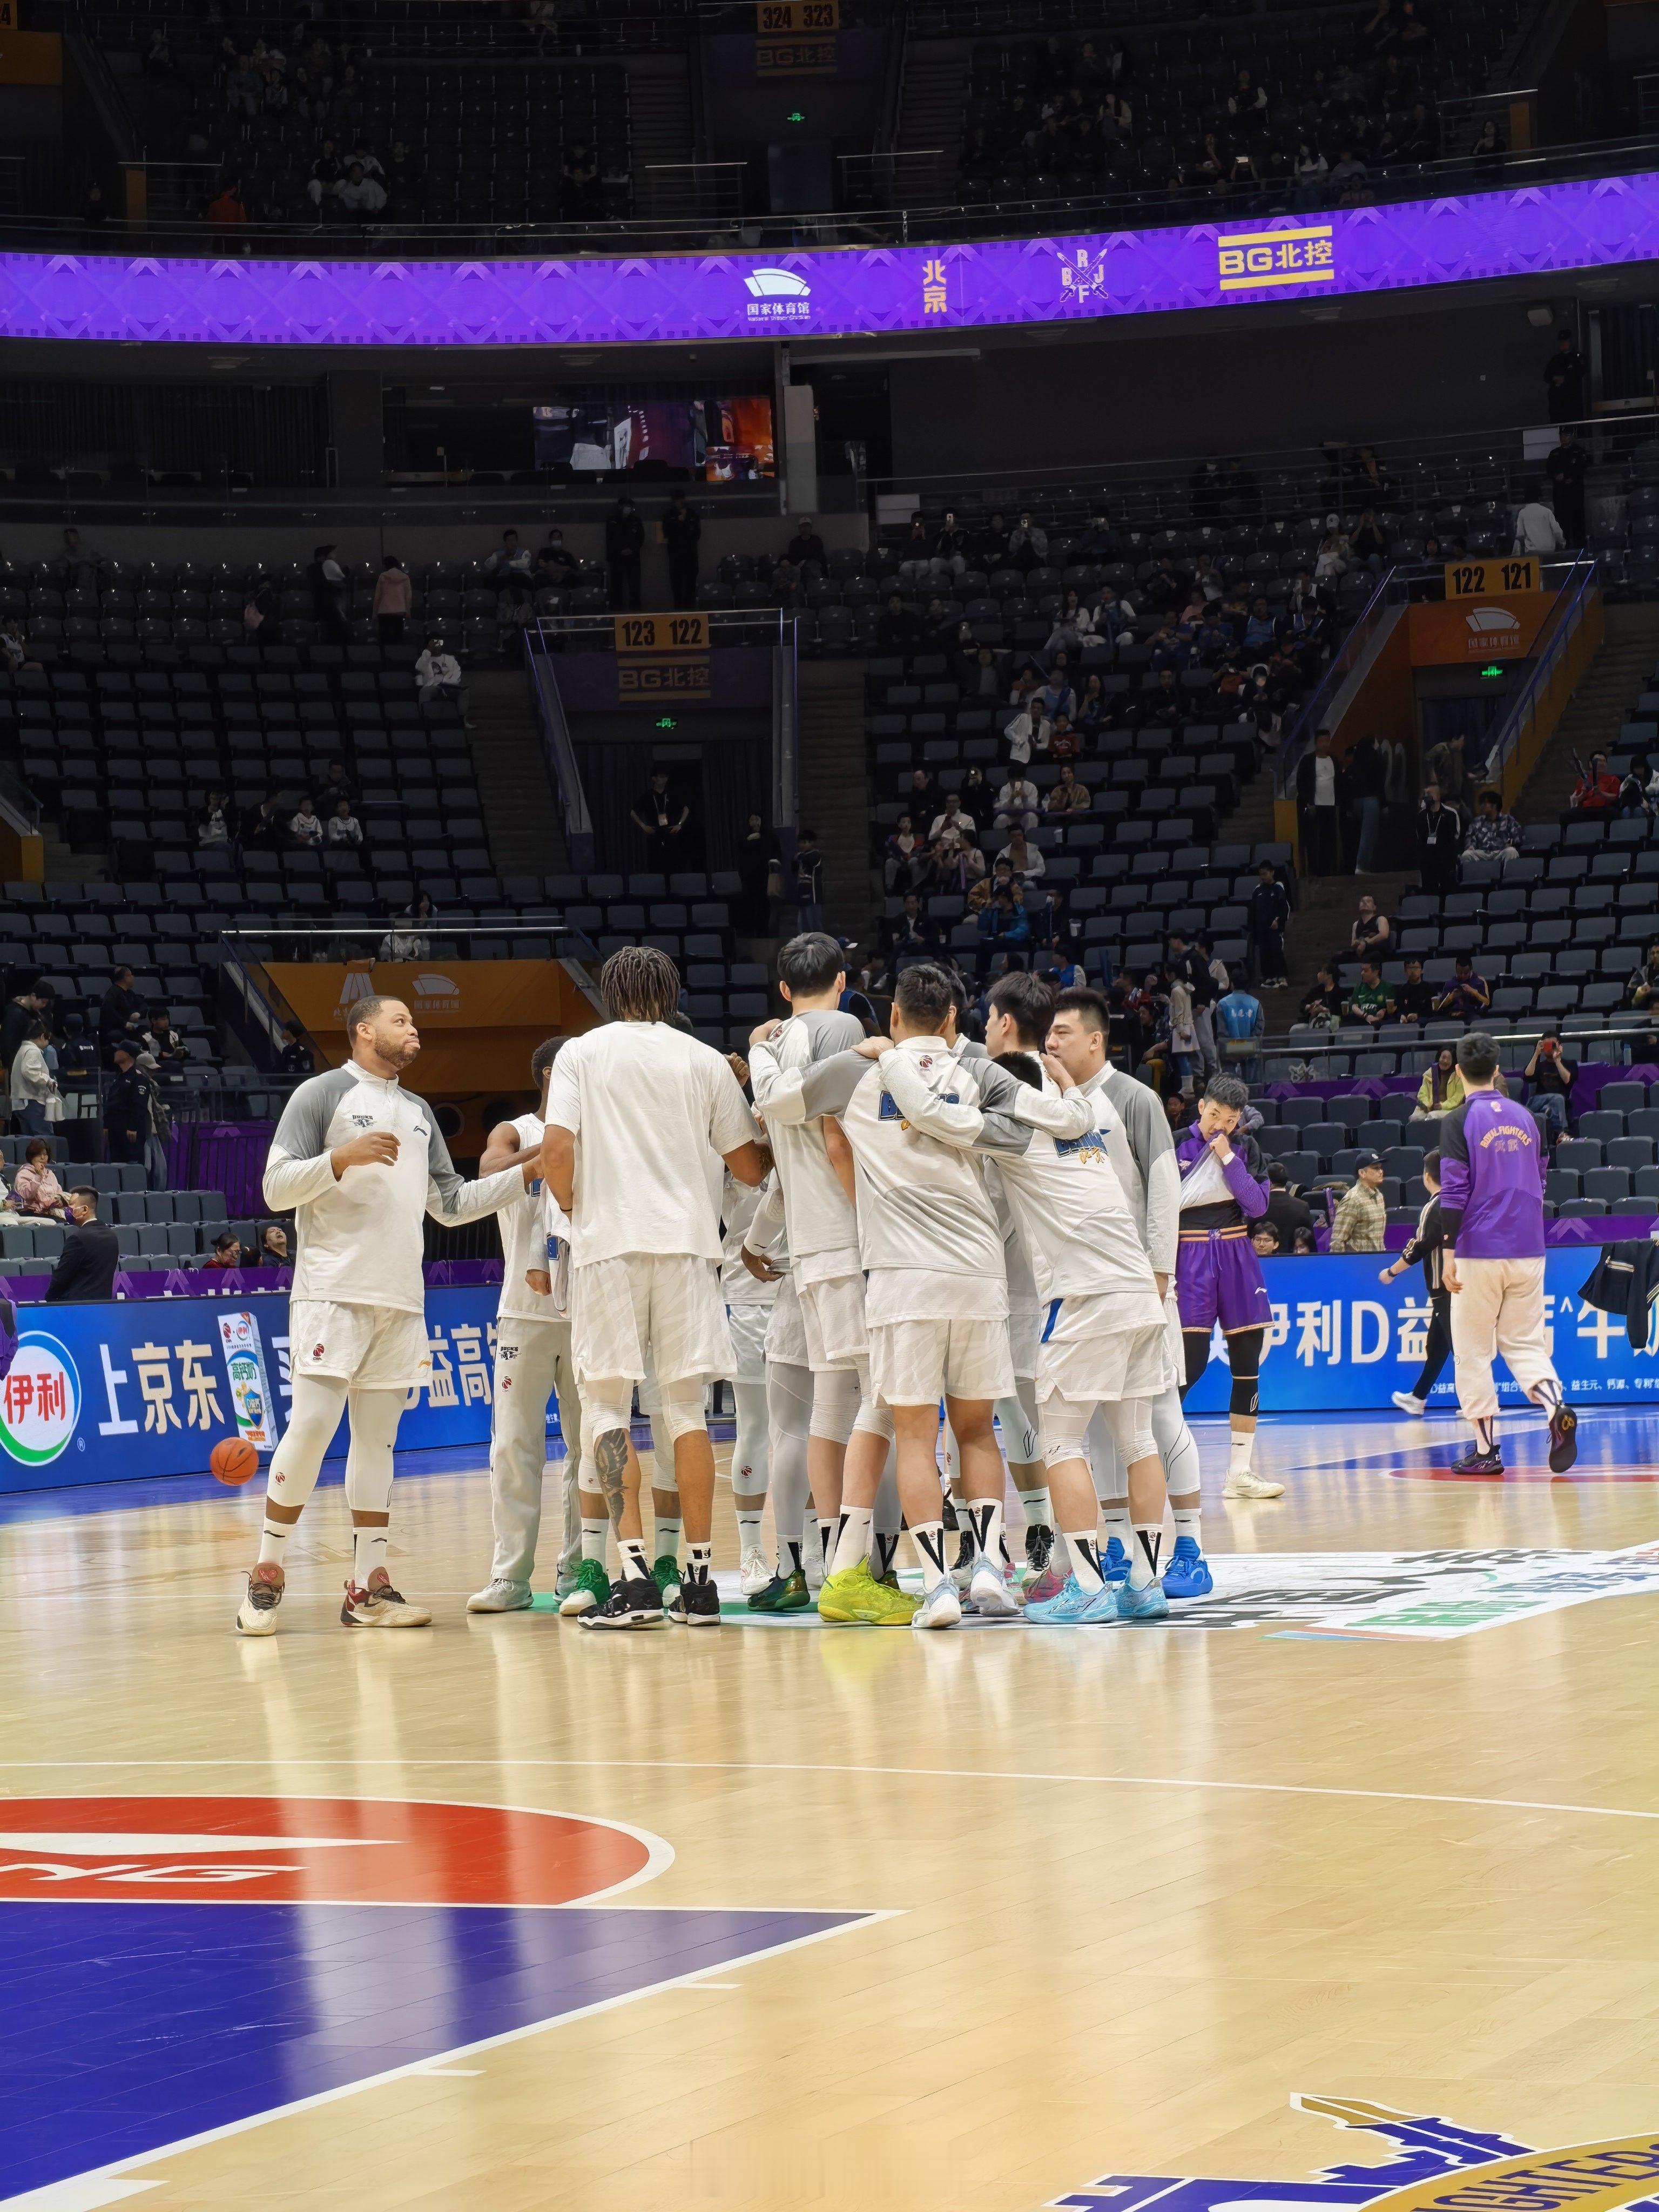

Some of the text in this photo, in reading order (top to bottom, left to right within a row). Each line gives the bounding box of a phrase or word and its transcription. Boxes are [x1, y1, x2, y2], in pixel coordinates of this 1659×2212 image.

[763, 4, 833, 29] 324 323
[1219, 240, 1333, 274] BG北控
[922, 260, 947, 313] 北京
[747, 302, 810, 315] 国家体育馆
[1453, 562, 1530, 594] 122 121
[622, 618, 701, 646] 123 122
[618, 667, 710, 689] BG北控
[4, 1371, 66, 1424] 伊利
[98, 1340, 225, 1436] 上京东
